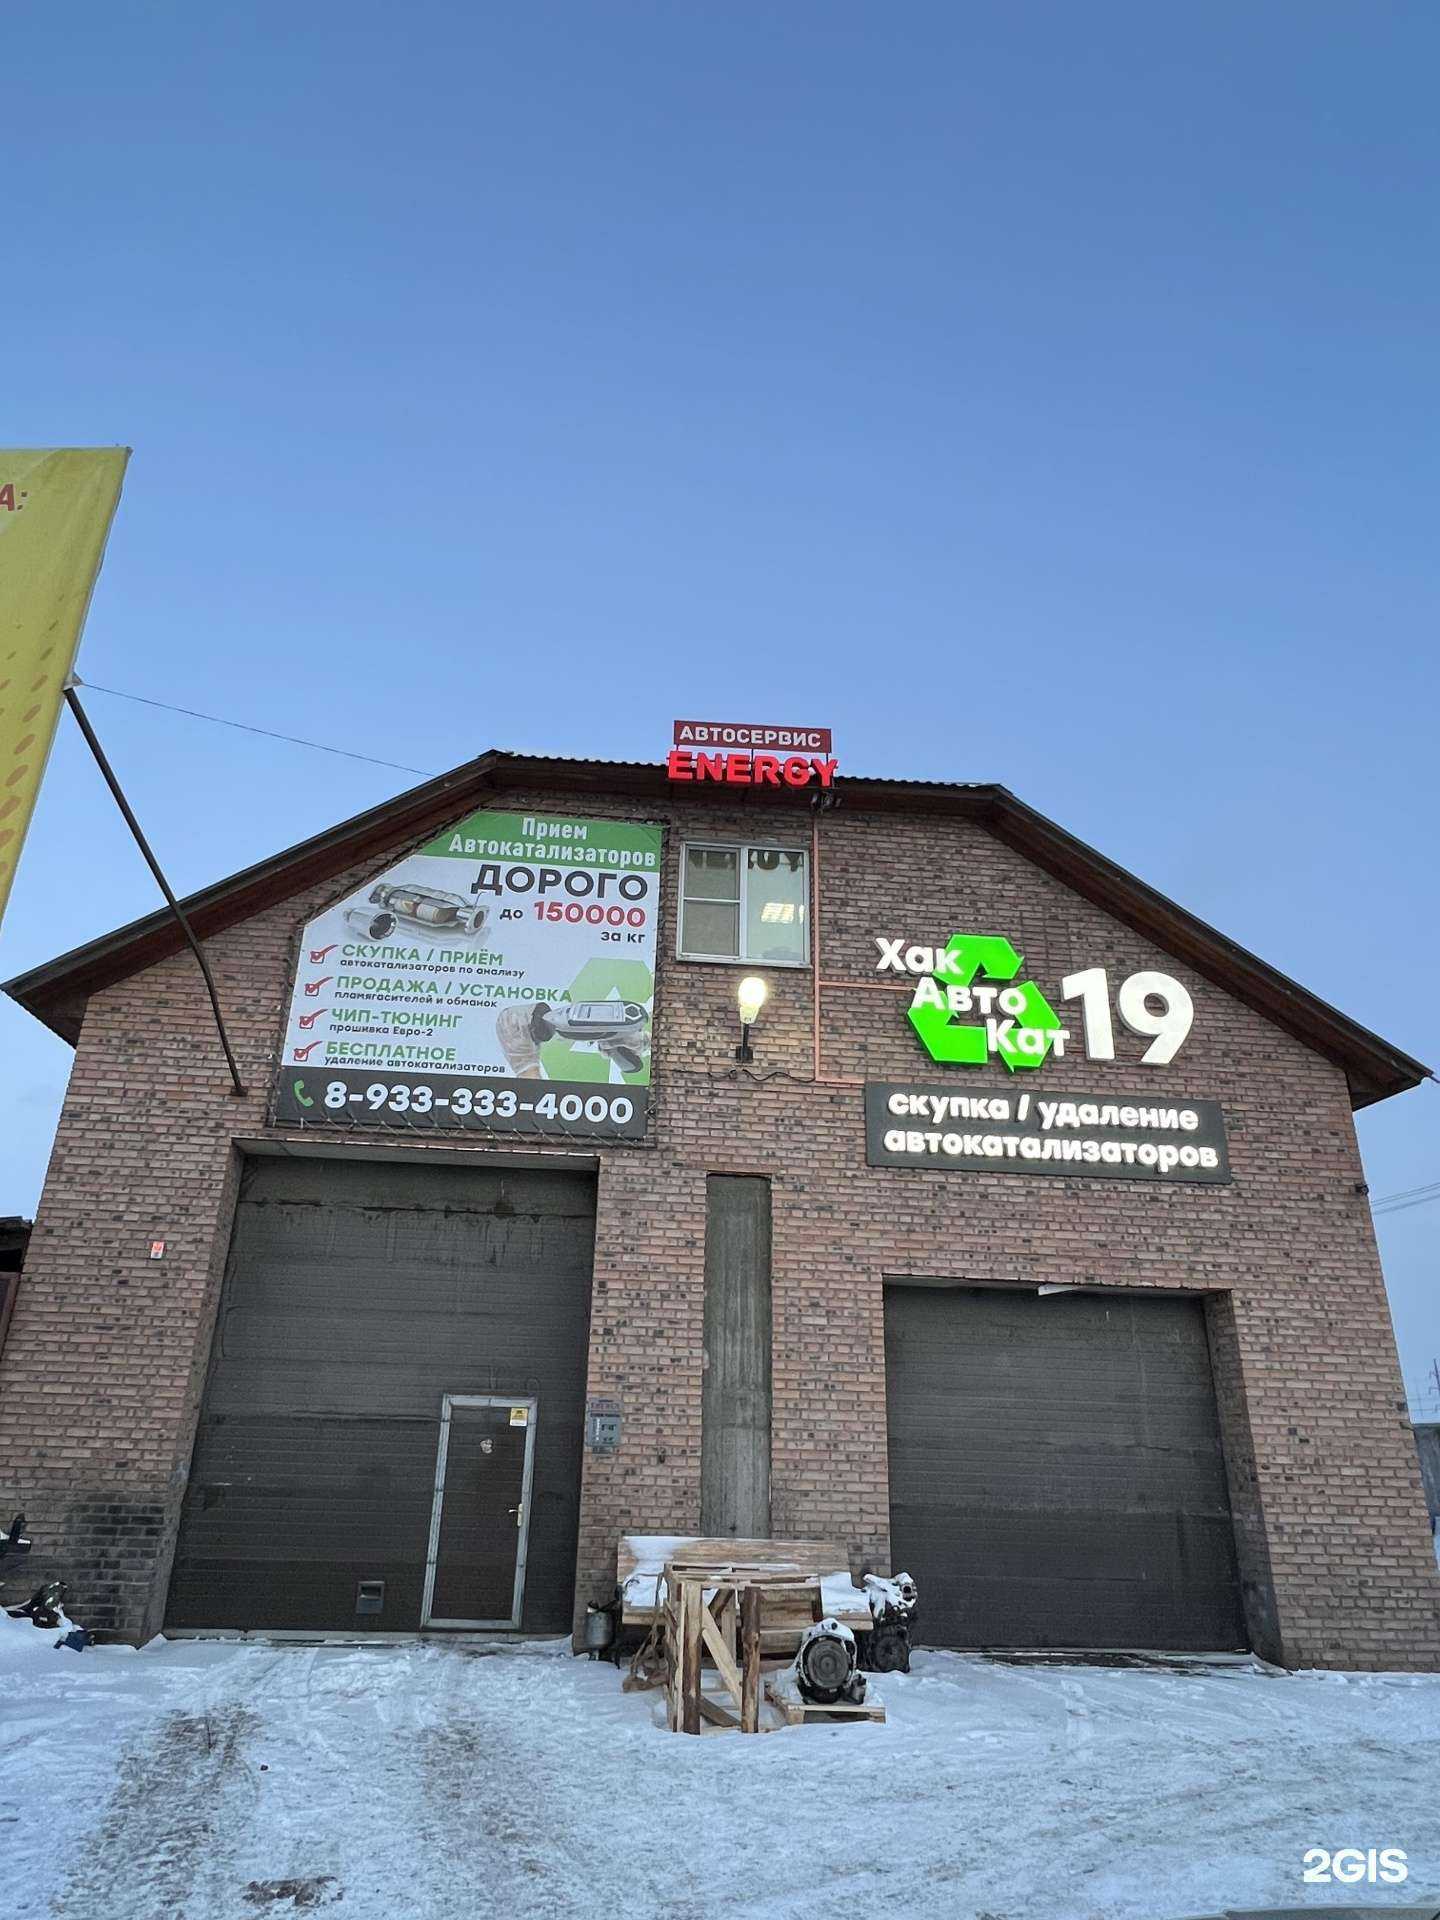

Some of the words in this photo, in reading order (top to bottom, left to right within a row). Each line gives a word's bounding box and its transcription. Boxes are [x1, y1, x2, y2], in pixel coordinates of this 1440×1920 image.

[679, 725, 822, 748] АВТОСЕРВИС
[667, 750, 839, 789] ENERGY
[521, 816, 588, 840] Прием
[448, 834, 656, 868] Автокатализаторов
[470, 864, 648, 901] ДОРОГО
[499, 908, 524, 921] до
[534, 901, 646, 928] 150000
[600, 931, 621, 942] за
[627, 932, 646, 944] кг
[342, 944, 420, 961] СКУПКА
[439, 949, 503, 966] ПРИЁМ
[875, 937, 964, 975] Хак
[340, 959, 455, 974] автокатализаторов
[459, 966, 473, 974] по
[476, 968, 525, 979] анализу
[334, 991, 433, 1005] пламягасителей
[436, 997, 443, 1005] и
[449, 996, 497, 1007] обманок
[337, 976, 438, 994] ПРОДАЖА
[459, 982, 572, 1002] УСТАНОВКА
[910, 976, 1028, 1015] Авто
[331, 1008, 463, 1028] ЧИП-ТЮНИНГ
[1061, 968, 1195, 1065] 19
[329, 1023, 389, 1035] прошивка
[393, 1026, 433, 1037] Евро-2
[985, 1018, 1071, 1057] Кат
[326, 1041, 457, 1061] БЕСПЛАТНОЕ
[324, 1055, 383, 1066] удаление
[386, 1059, 506, 1075] автокатализаторов
[324, 1081, 634, 1124] 8-933-333-4000
[887, 1092, 1010, 1124] скупка
[1037, 1101, 1199, 1130] удаление
[883, 1129, 1219, 1173] автокатализаторов
